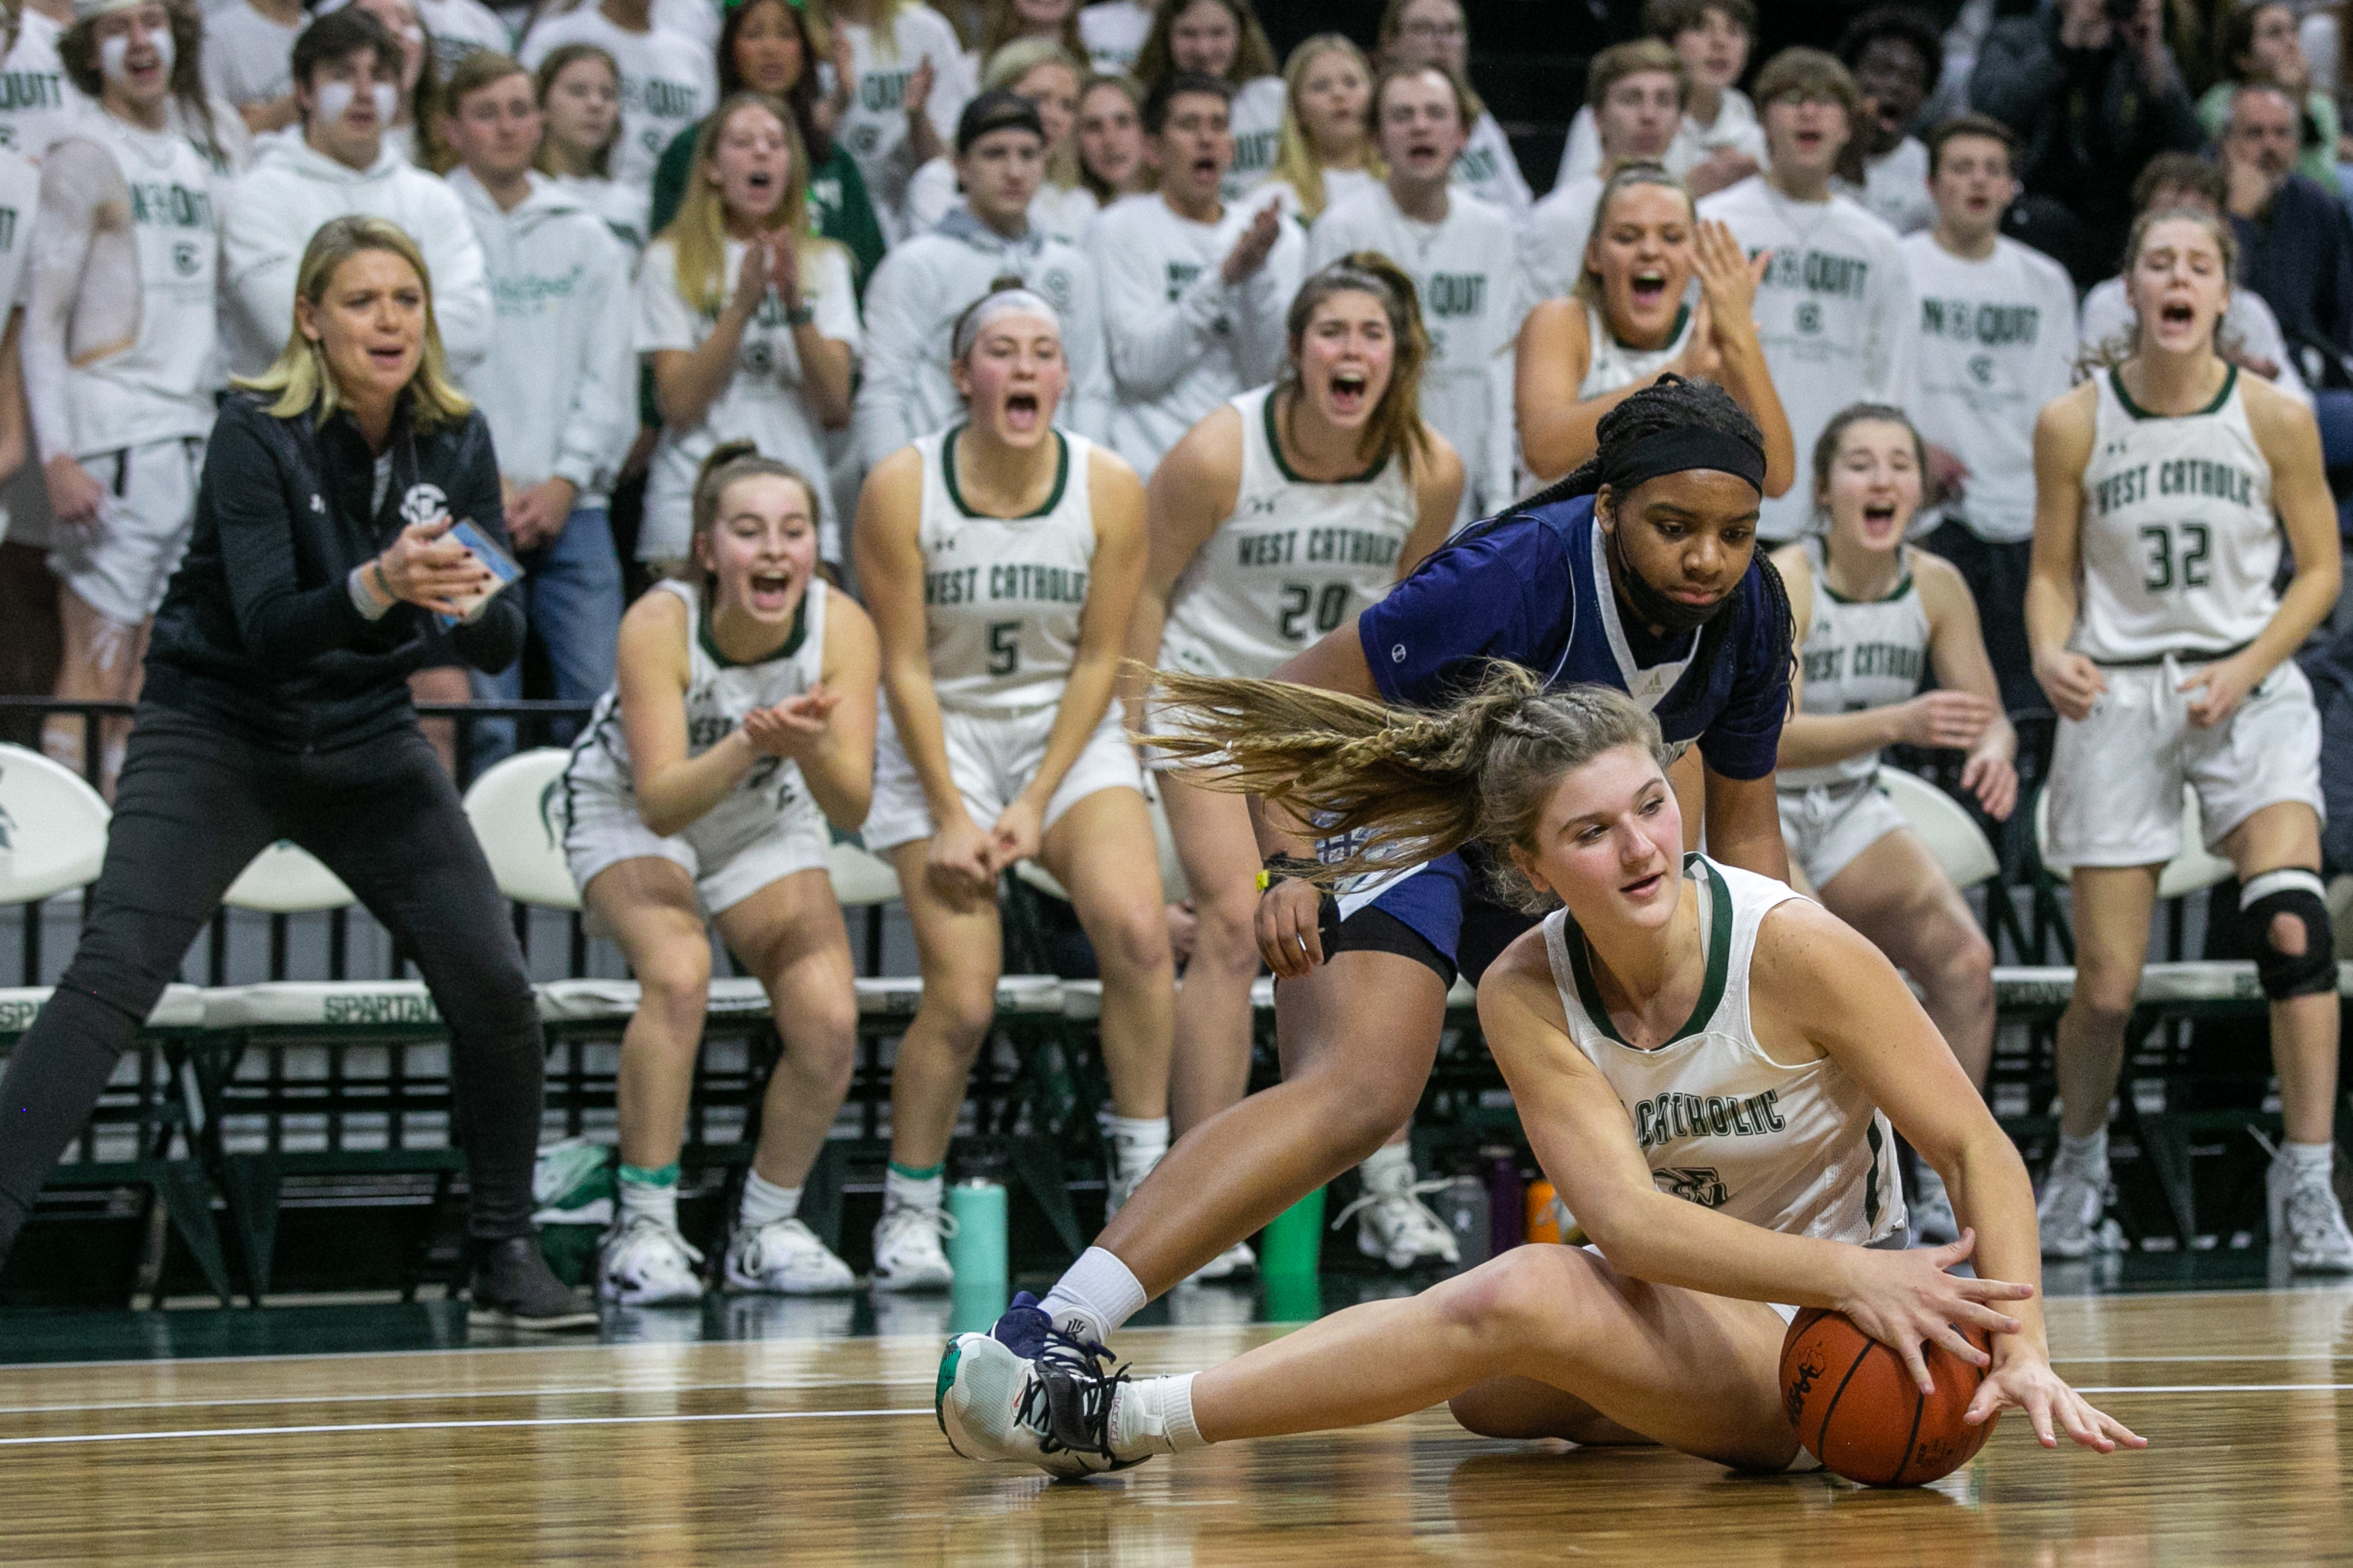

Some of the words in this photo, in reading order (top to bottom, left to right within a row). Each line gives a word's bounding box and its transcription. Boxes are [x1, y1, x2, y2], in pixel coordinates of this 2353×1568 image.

[1430, 273, 1487, 318] QUIT
[1804, 250, 1868, 298] QUIT
[1976, 304, 2039, 346] QUIT
[2098, 464, 2148, 515] WEST
[1239, 530, 1297, 566] WEST
[2139, 524, 2210, 592] 32
[1279, 582, 1351, 639] 20
[986, 620, 1021, 676] 5
[1636, 1088, 1785, 1147] CATHOLIC
